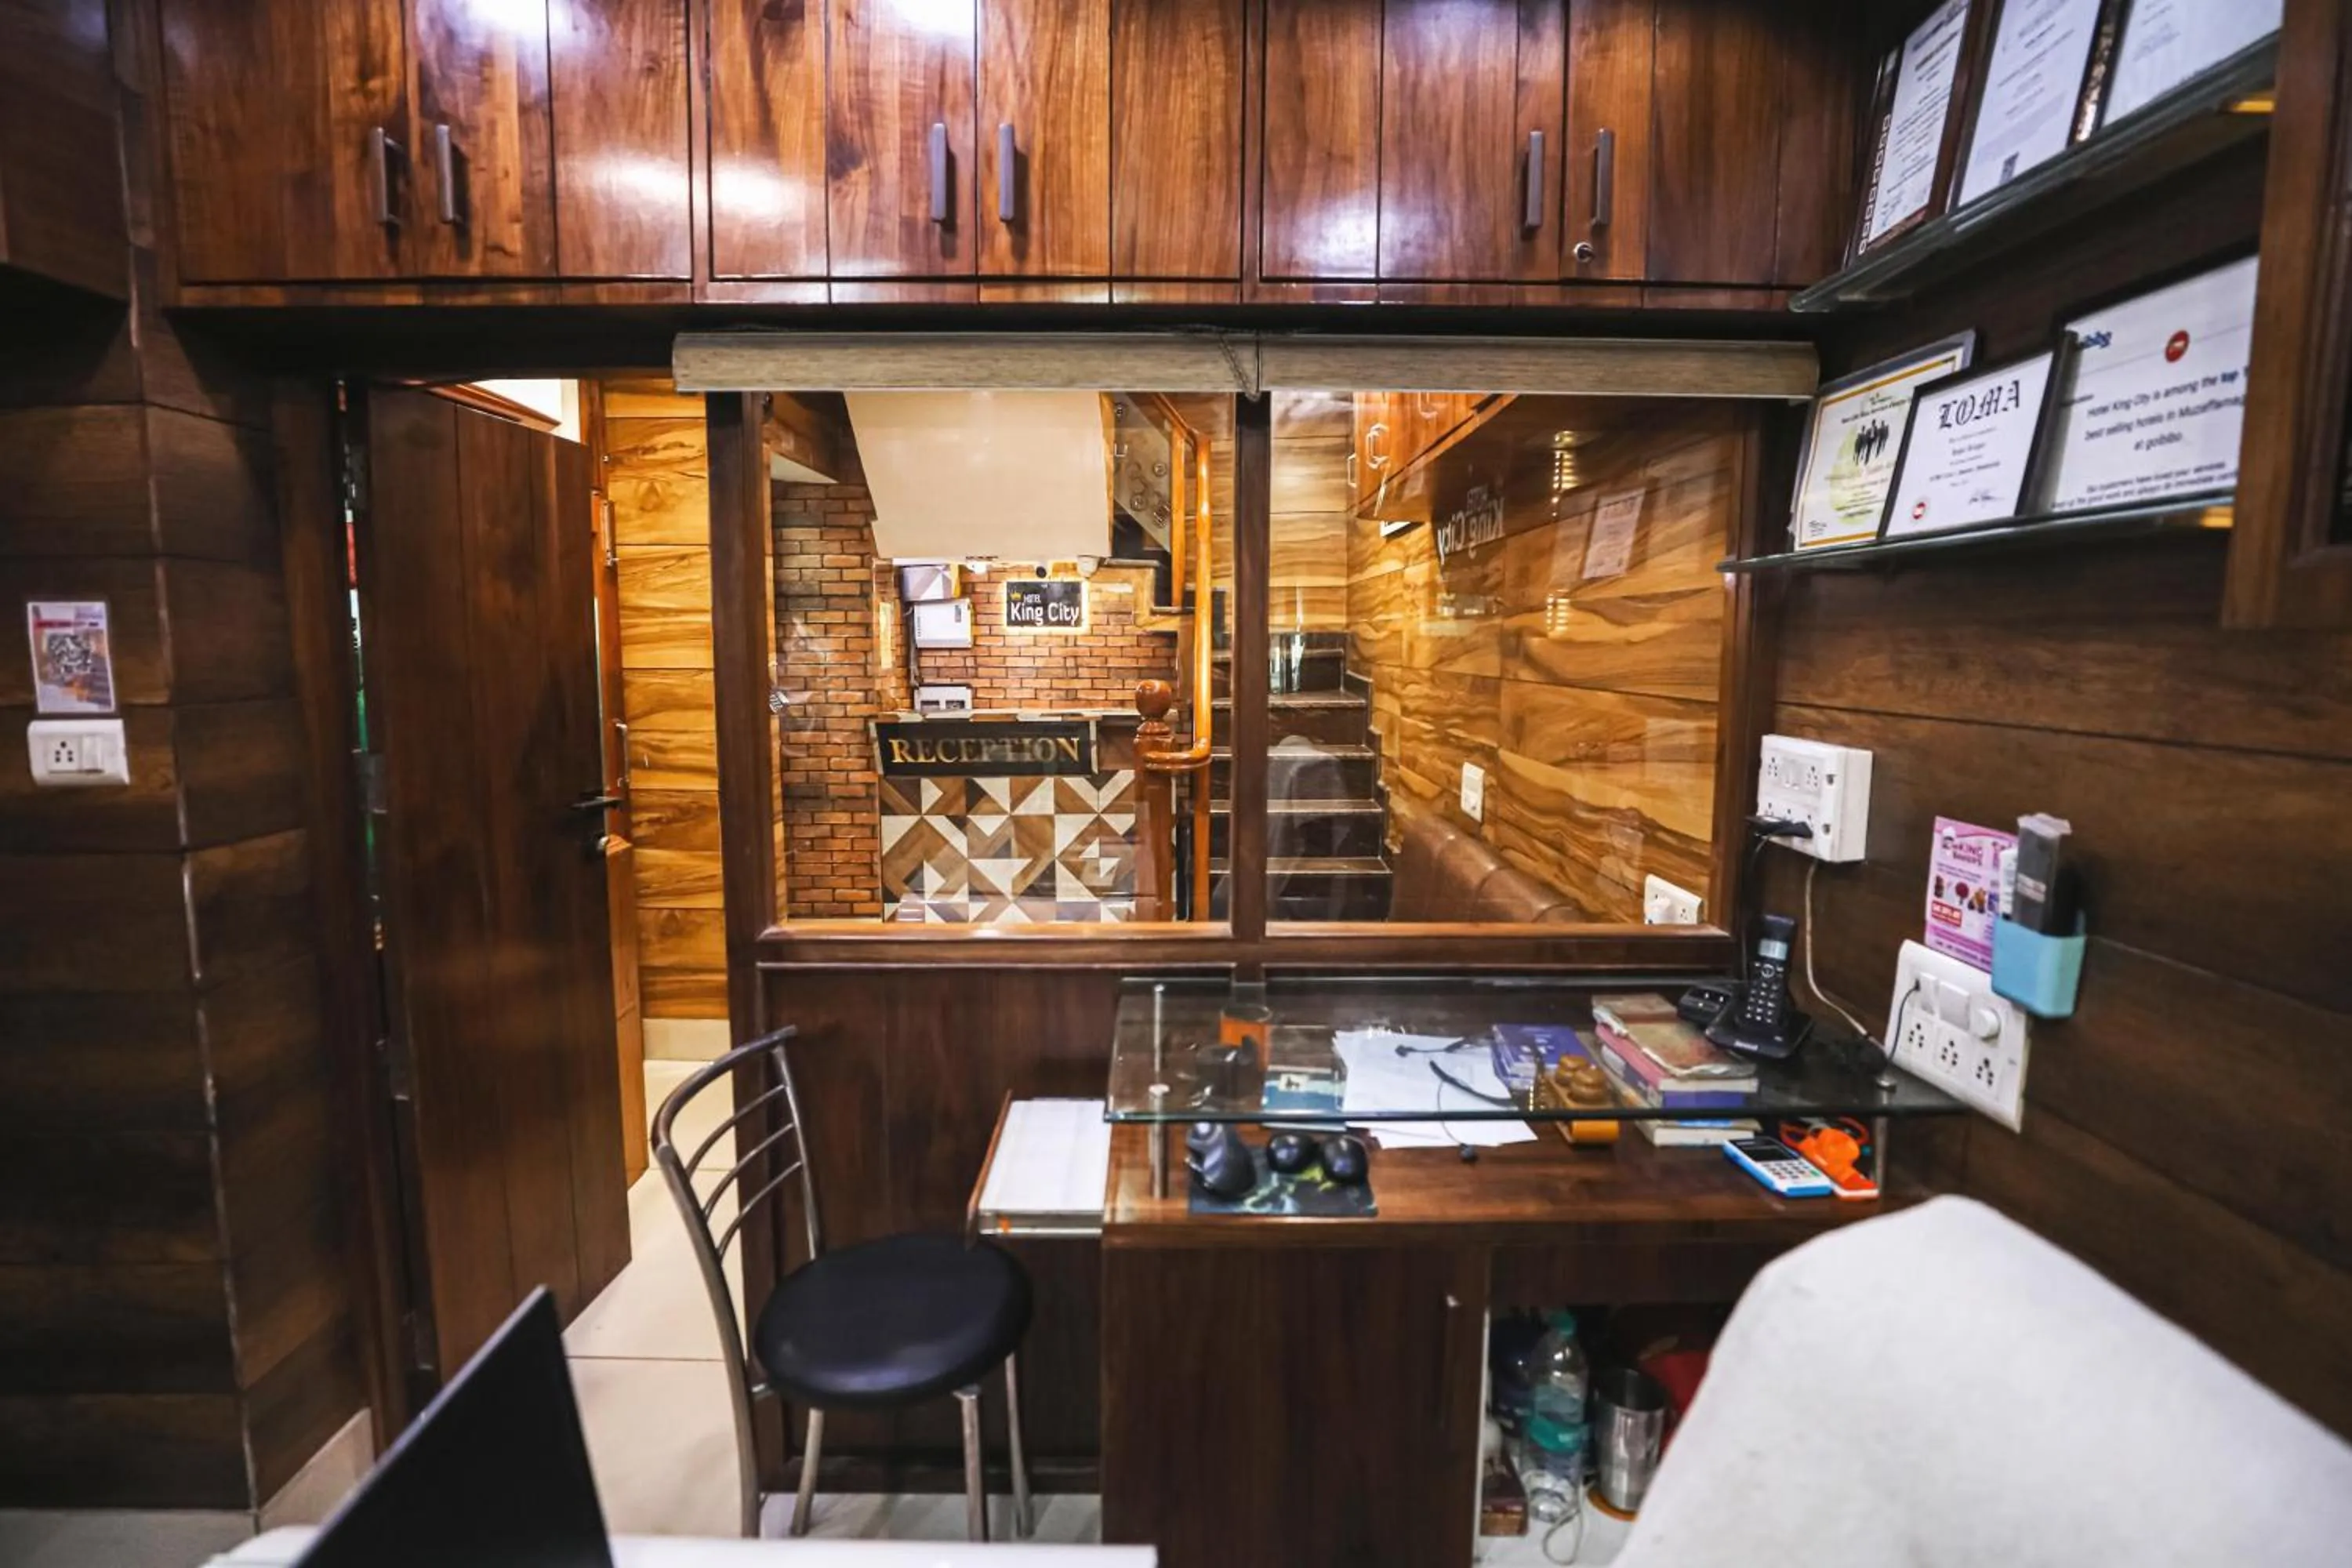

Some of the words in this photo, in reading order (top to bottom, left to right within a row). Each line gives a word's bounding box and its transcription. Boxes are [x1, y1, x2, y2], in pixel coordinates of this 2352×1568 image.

[2087, 404, 2110, 419] Hotel
[2112, 399, 2133, 413] King
[2133, 394, 2151, 407] City
[2153, 390, 2161, 401] is
[2164, 380, 2199, 397] among
[2201, 375, 2218, 388] the
[2220, 370, 2240, 384] top
[2085, 427, 2105, 441] best
[2106, 419, 2134, 436] selling
[2136, 413, 2164, 428] hotels
[2166, 409, 2176, 420] in
[2133, 439, 2144, 452] at
[1011, 601, 1044, 626] King
[1047, 601, 1080, 626] City
[888, 737, 1080, 764] RECEPTION
